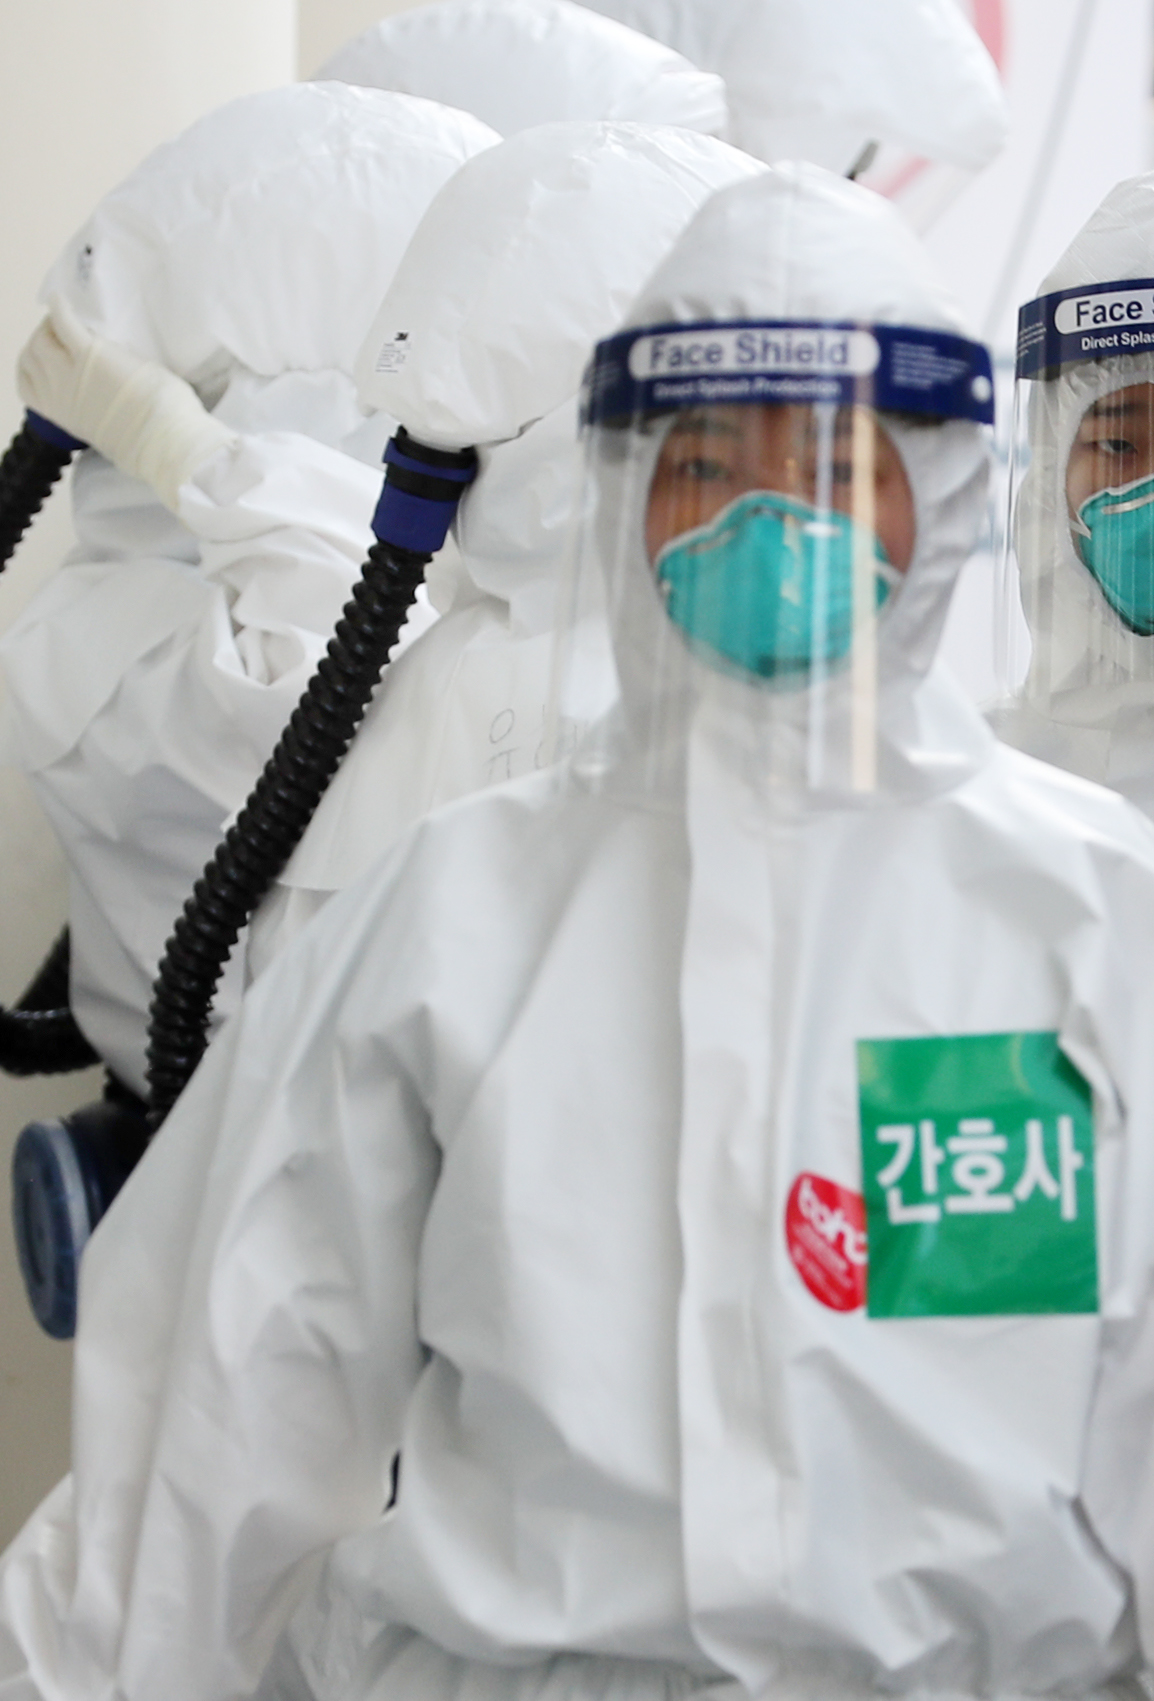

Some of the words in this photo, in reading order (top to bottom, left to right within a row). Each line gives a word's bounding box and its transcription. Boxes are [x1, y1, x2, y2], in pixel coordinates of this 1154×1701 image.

[1076, 300, 1143, 327] Face
[648, 337, 723, 371] Face
[734, 329, 850, 368] Shield
[1081, 335, 1119, 351] Direct
[876, 1115, 1084, 1225] 간호사
